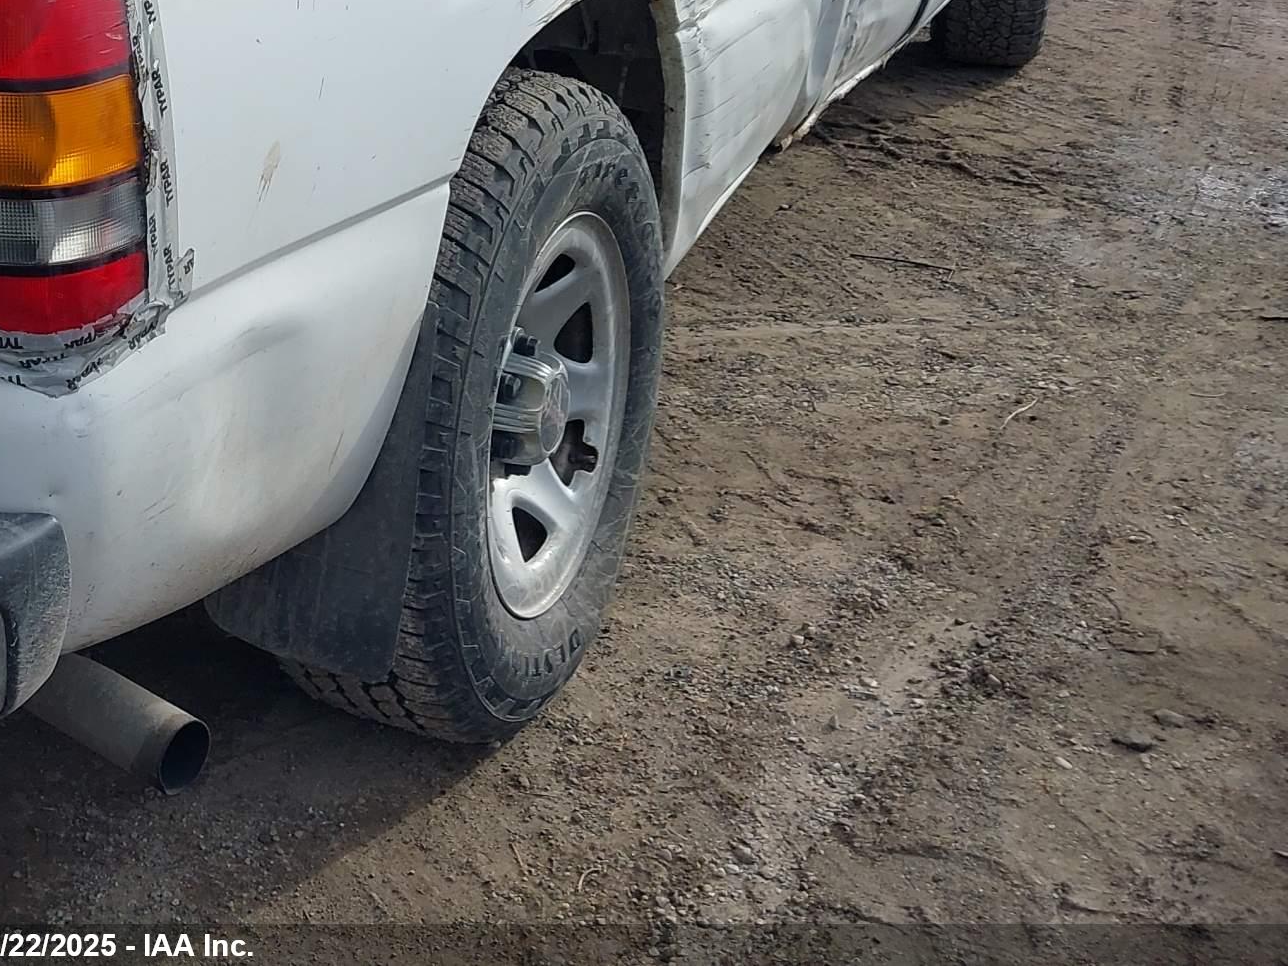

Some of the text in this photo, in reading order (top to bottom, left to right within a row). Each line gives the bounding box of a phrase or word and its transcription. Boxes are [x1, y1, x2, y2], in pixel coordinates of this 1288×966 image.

[151, 66, 168, 118] TYPAR
[160, 158, 174, 208] TYPAR
[148, 212, 158, 261] TYPAR
[163, 243, 177, 290] TYPAR
